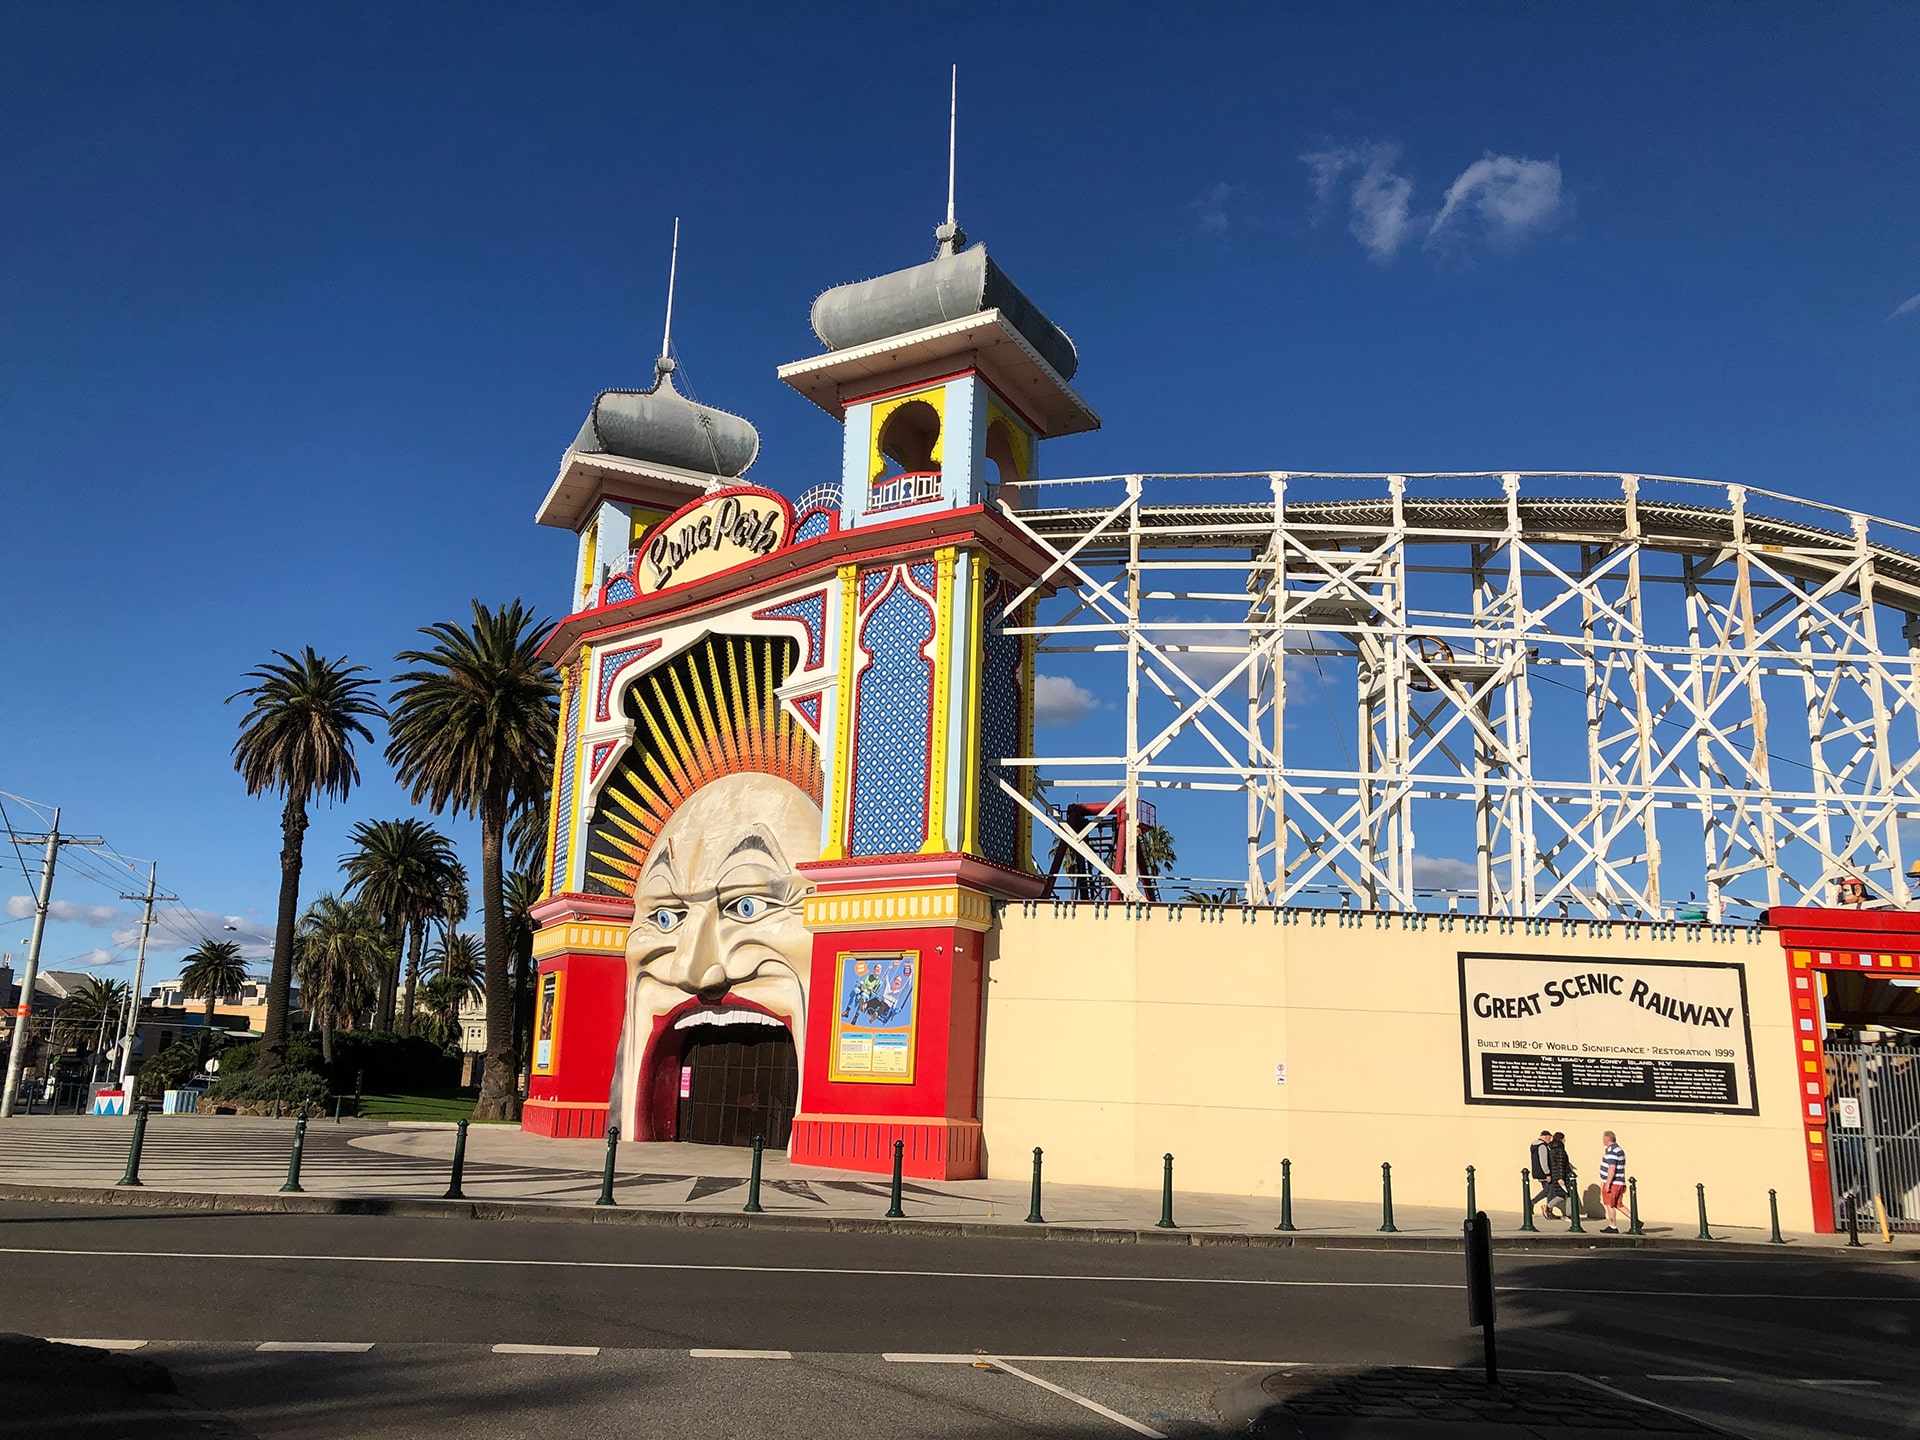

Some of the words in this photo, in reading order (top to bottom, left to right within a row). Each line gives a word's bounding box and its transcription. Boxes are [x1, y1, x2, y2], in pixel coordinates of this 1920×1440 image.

[647, 515, 712, 590] Luna
[710, 496, 779, 555] Park
[1473, 992, 1542, 1019] GREAT
[1544, 973, 1624, 1007] SCENIC
[1629, 979, 1734, 1028] RAILWAY
[1477, 1039, 1499, 1048] BUILT
[1512, 1040, 1528, 1049] 1912
[1546, 1042, 1579, 1051] WORLD
[1582, 1043, 1645, 1054] SIGNIFICANCE
[1652, 1046, 1711, 1057] RESTORATION
[1715, 1048, 1735, 1057] 1999
